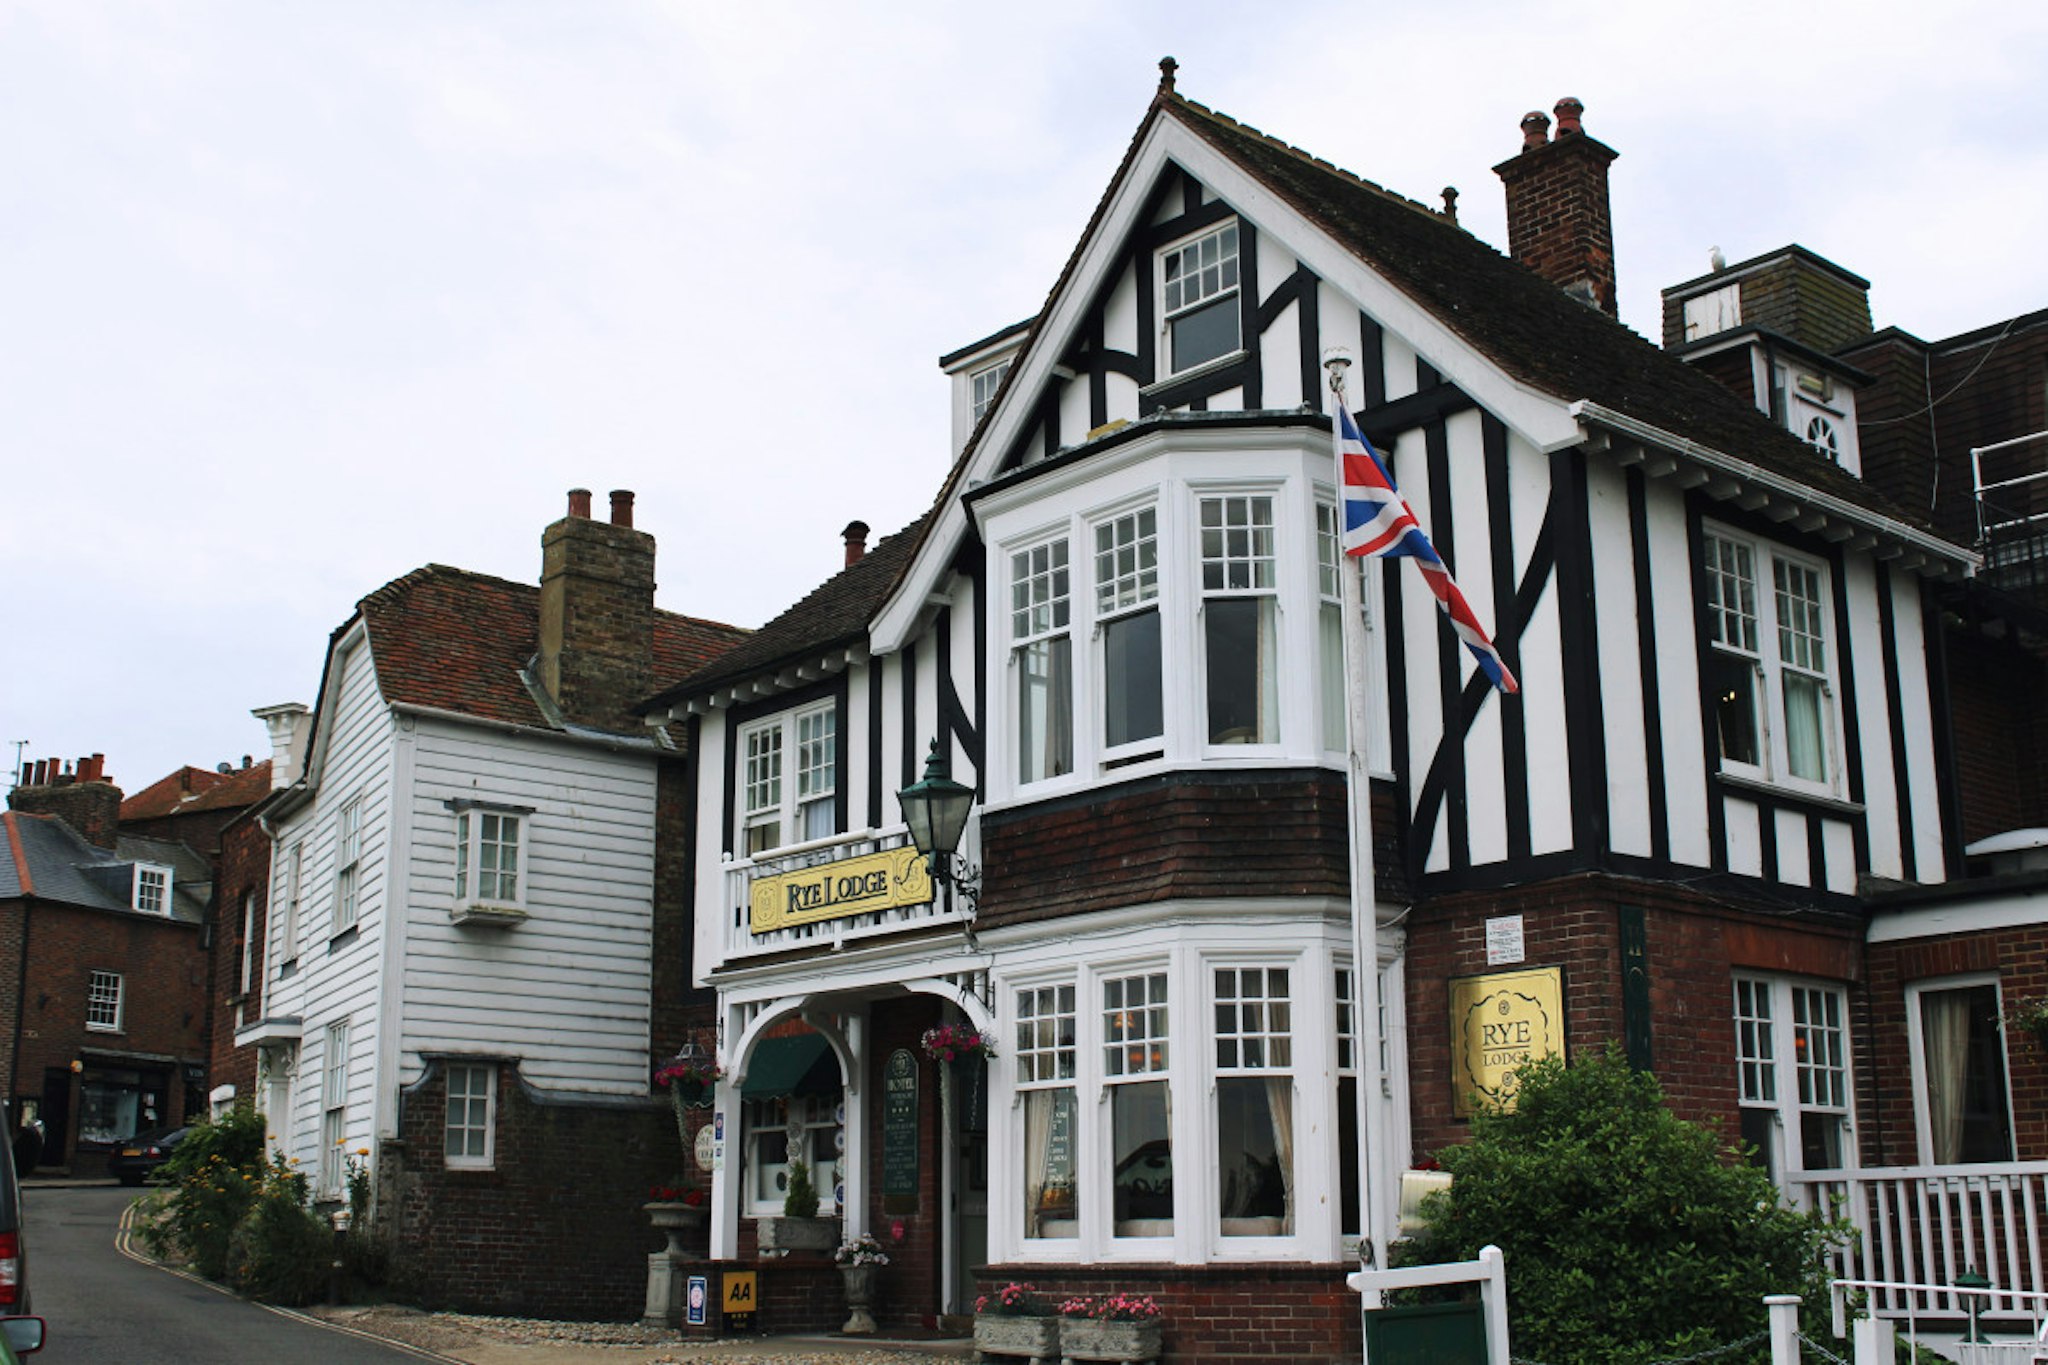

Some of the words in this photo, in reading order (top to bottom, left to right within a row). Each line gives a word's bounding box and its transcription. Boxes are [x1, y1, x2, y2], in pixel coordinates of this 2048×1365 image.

[786, 883, 821, 914] RYE
[824, 870, 888, 904] LODGE
[1482, 1020, 1532, 1046] RYE
[730, 1282, 751, 1302] AA
